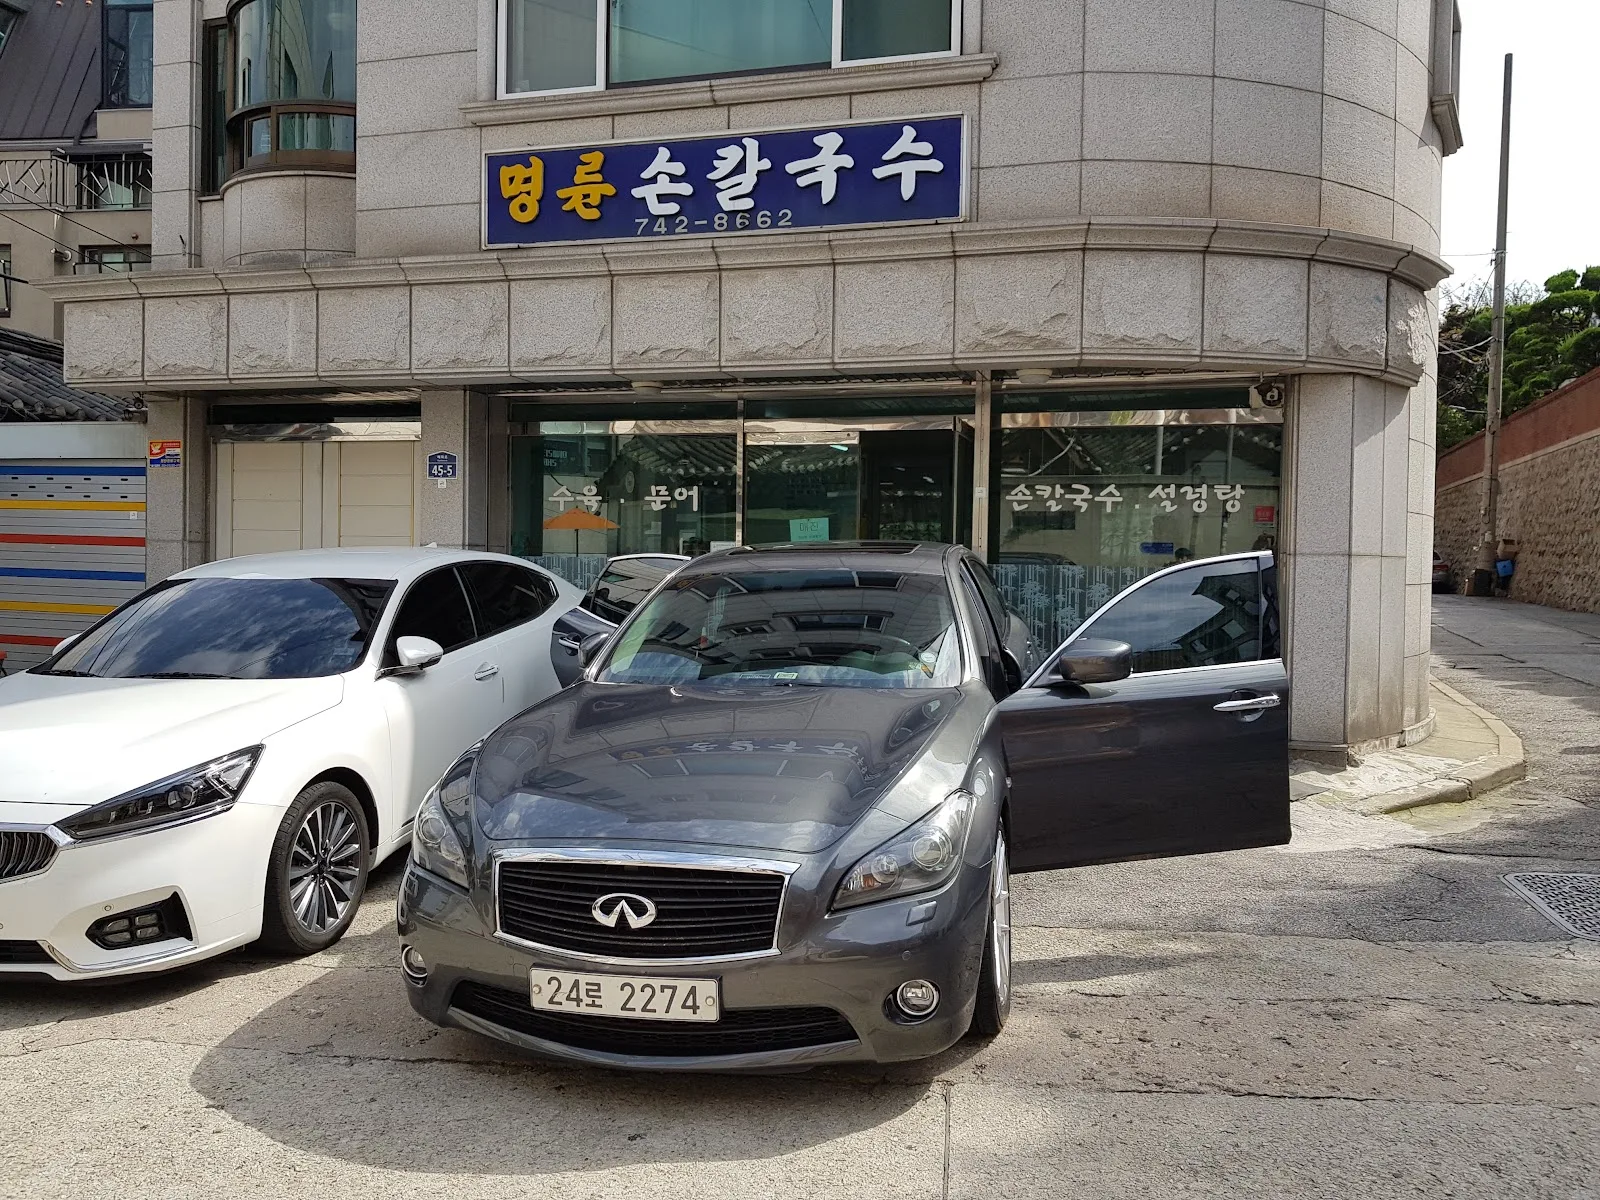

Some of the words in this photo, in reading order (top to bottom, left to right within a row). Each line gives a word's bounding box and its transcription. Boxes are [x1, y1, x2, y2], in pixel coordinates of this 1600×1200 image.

[500, 151, 617, 223] 명륜
[631, 125, 944, 216] 손칼국수
[635, 209, 793, 235] 742-8662
[431, 464, 453, 476] 45-5
[549, 485, 602, 512] 수육
[644, 485, 699, 512] 문어
[1005, 483, 1123, 513] 손칼국수
[1149, 483, 1246, 513] 설렁탕
[547, 976, 603, 1009] 24로
[619, 981, 701, 1015] 2274
